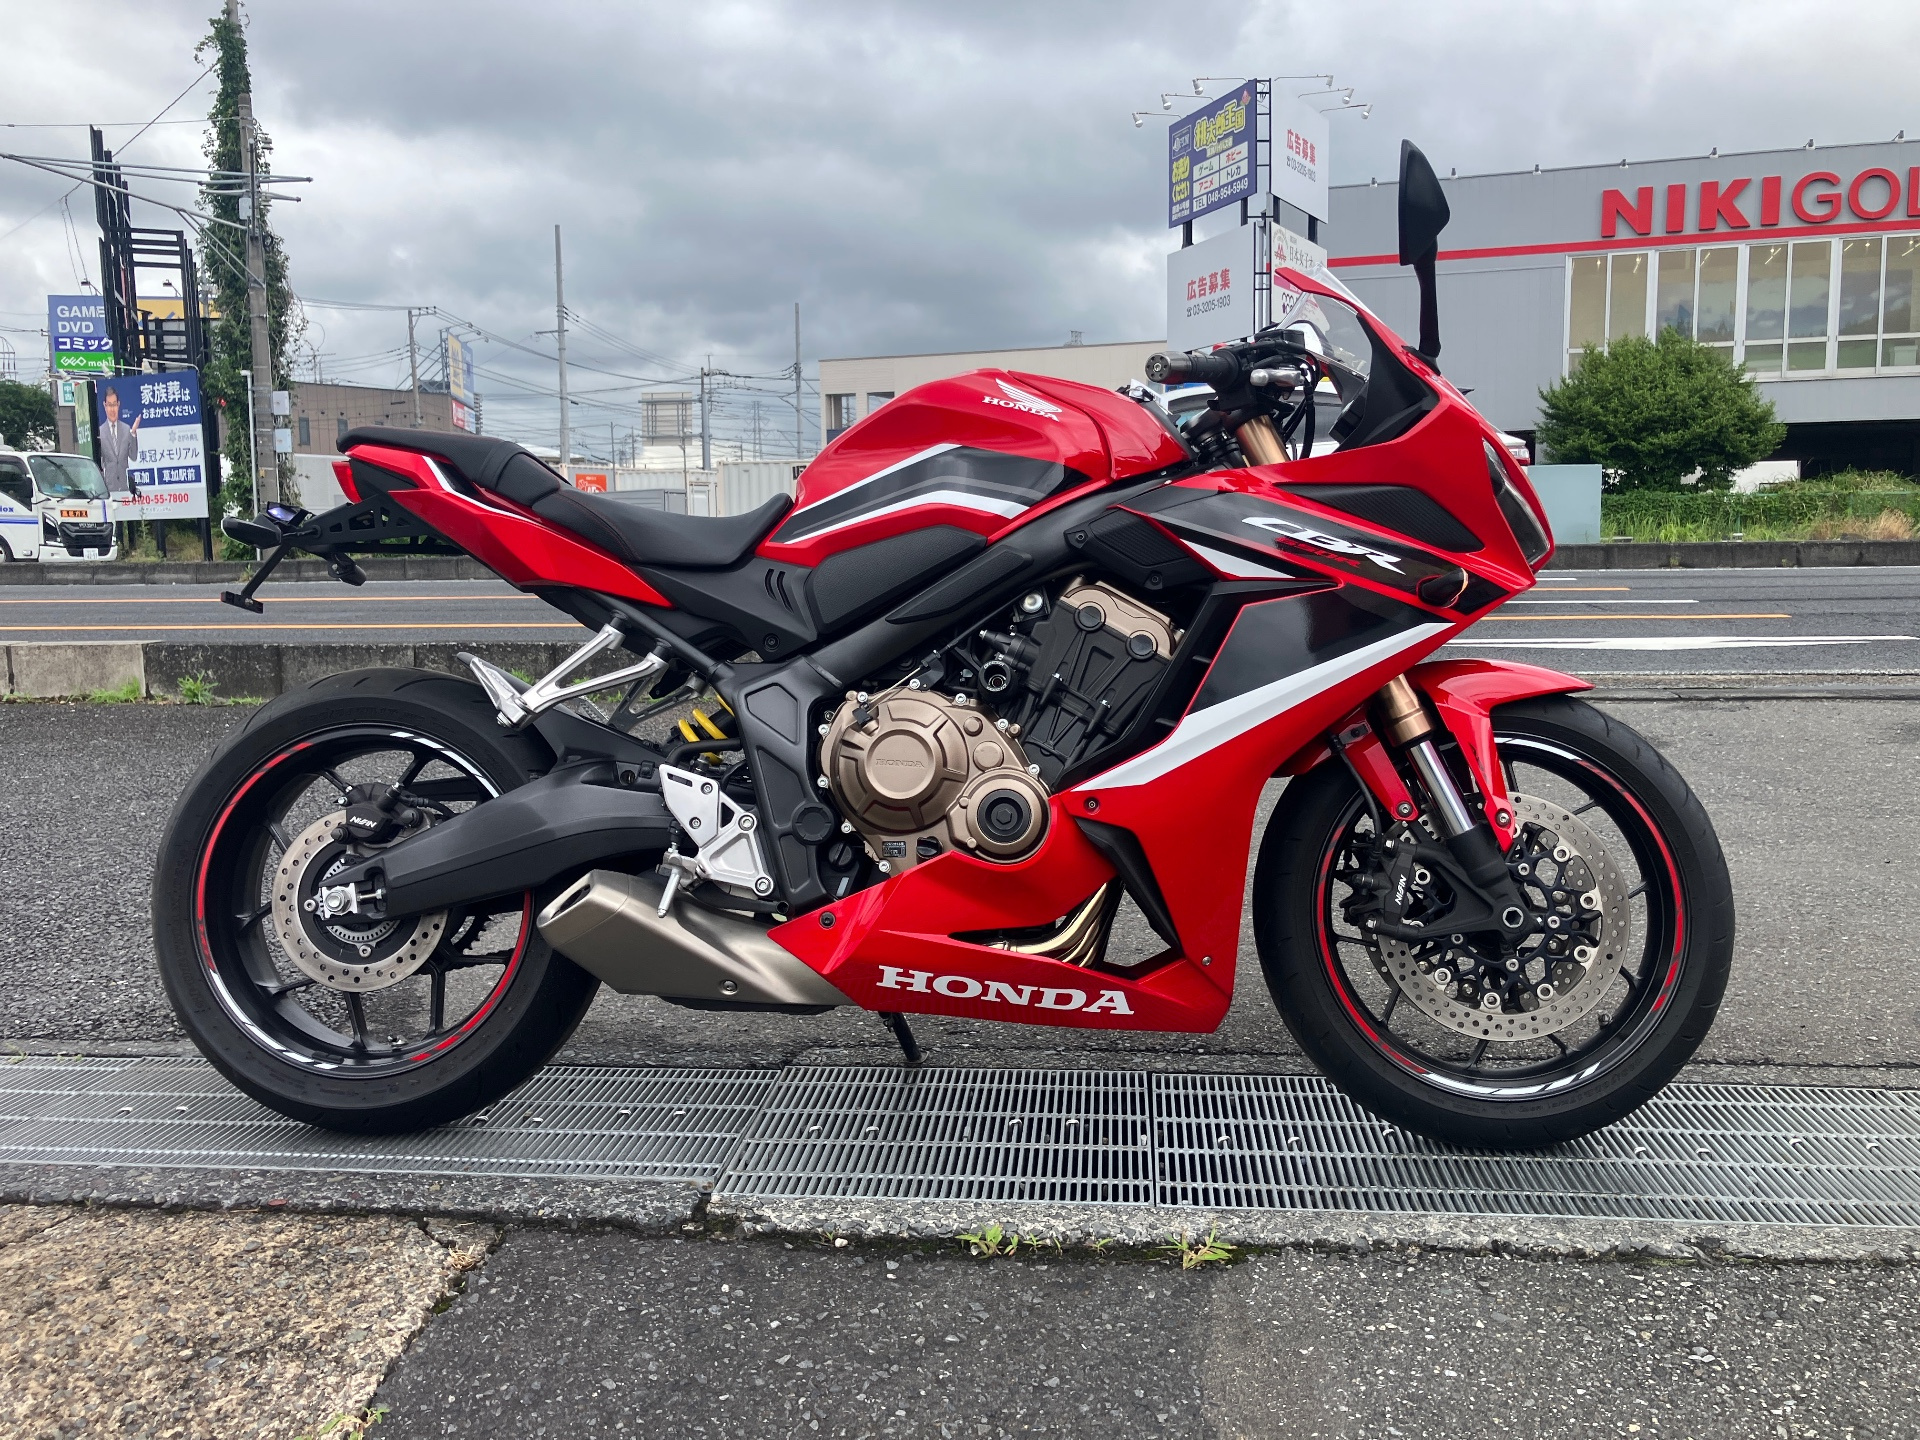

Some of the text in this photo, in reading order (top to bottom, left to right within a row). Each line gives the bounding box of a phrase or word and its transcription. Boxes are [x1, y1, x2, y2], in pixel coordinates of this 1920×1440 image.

[1194, 100, 1245, 150] 桃太郎王国
[1287, 129, 1316, 166] 広告募集
[1225, 148, 1242, 165] ホビー
[1198, 160, 1214, 176] ゲーム
[1226, 165, 1241, 181] トレカ
[1198, 177, 1214, 193] アニメ
[1195, 198, 1206, 210] TEL
[1208, 178, 1249, 205] 048-954-5949
[1187, 268, 1231, 301] 広告募集
[56, 305, 105, 318] GAME
[1192, 294, 1231, 316] 03-3205-1903
[57, 321, 94, 334] DVD
[58, 337, 113, 351] コミック
[140, 380, 191, 405] 家族葬は
[142, 404, 197, 419] おまかせください
[982, 395, 1060, 422] HONDA
[139, 447, 200, 463] 東冠メモリアル
[162, 468, 196, 483] 草加駅前
[1241, 516, 1406, 576] CBR
[876, 758, 925, 768] HONDA
[349, 815, 378, 829] NISSIN
[1394, 873, 1408, 906] NISSIN
[876, 965, 1135, 1015] HONDA
